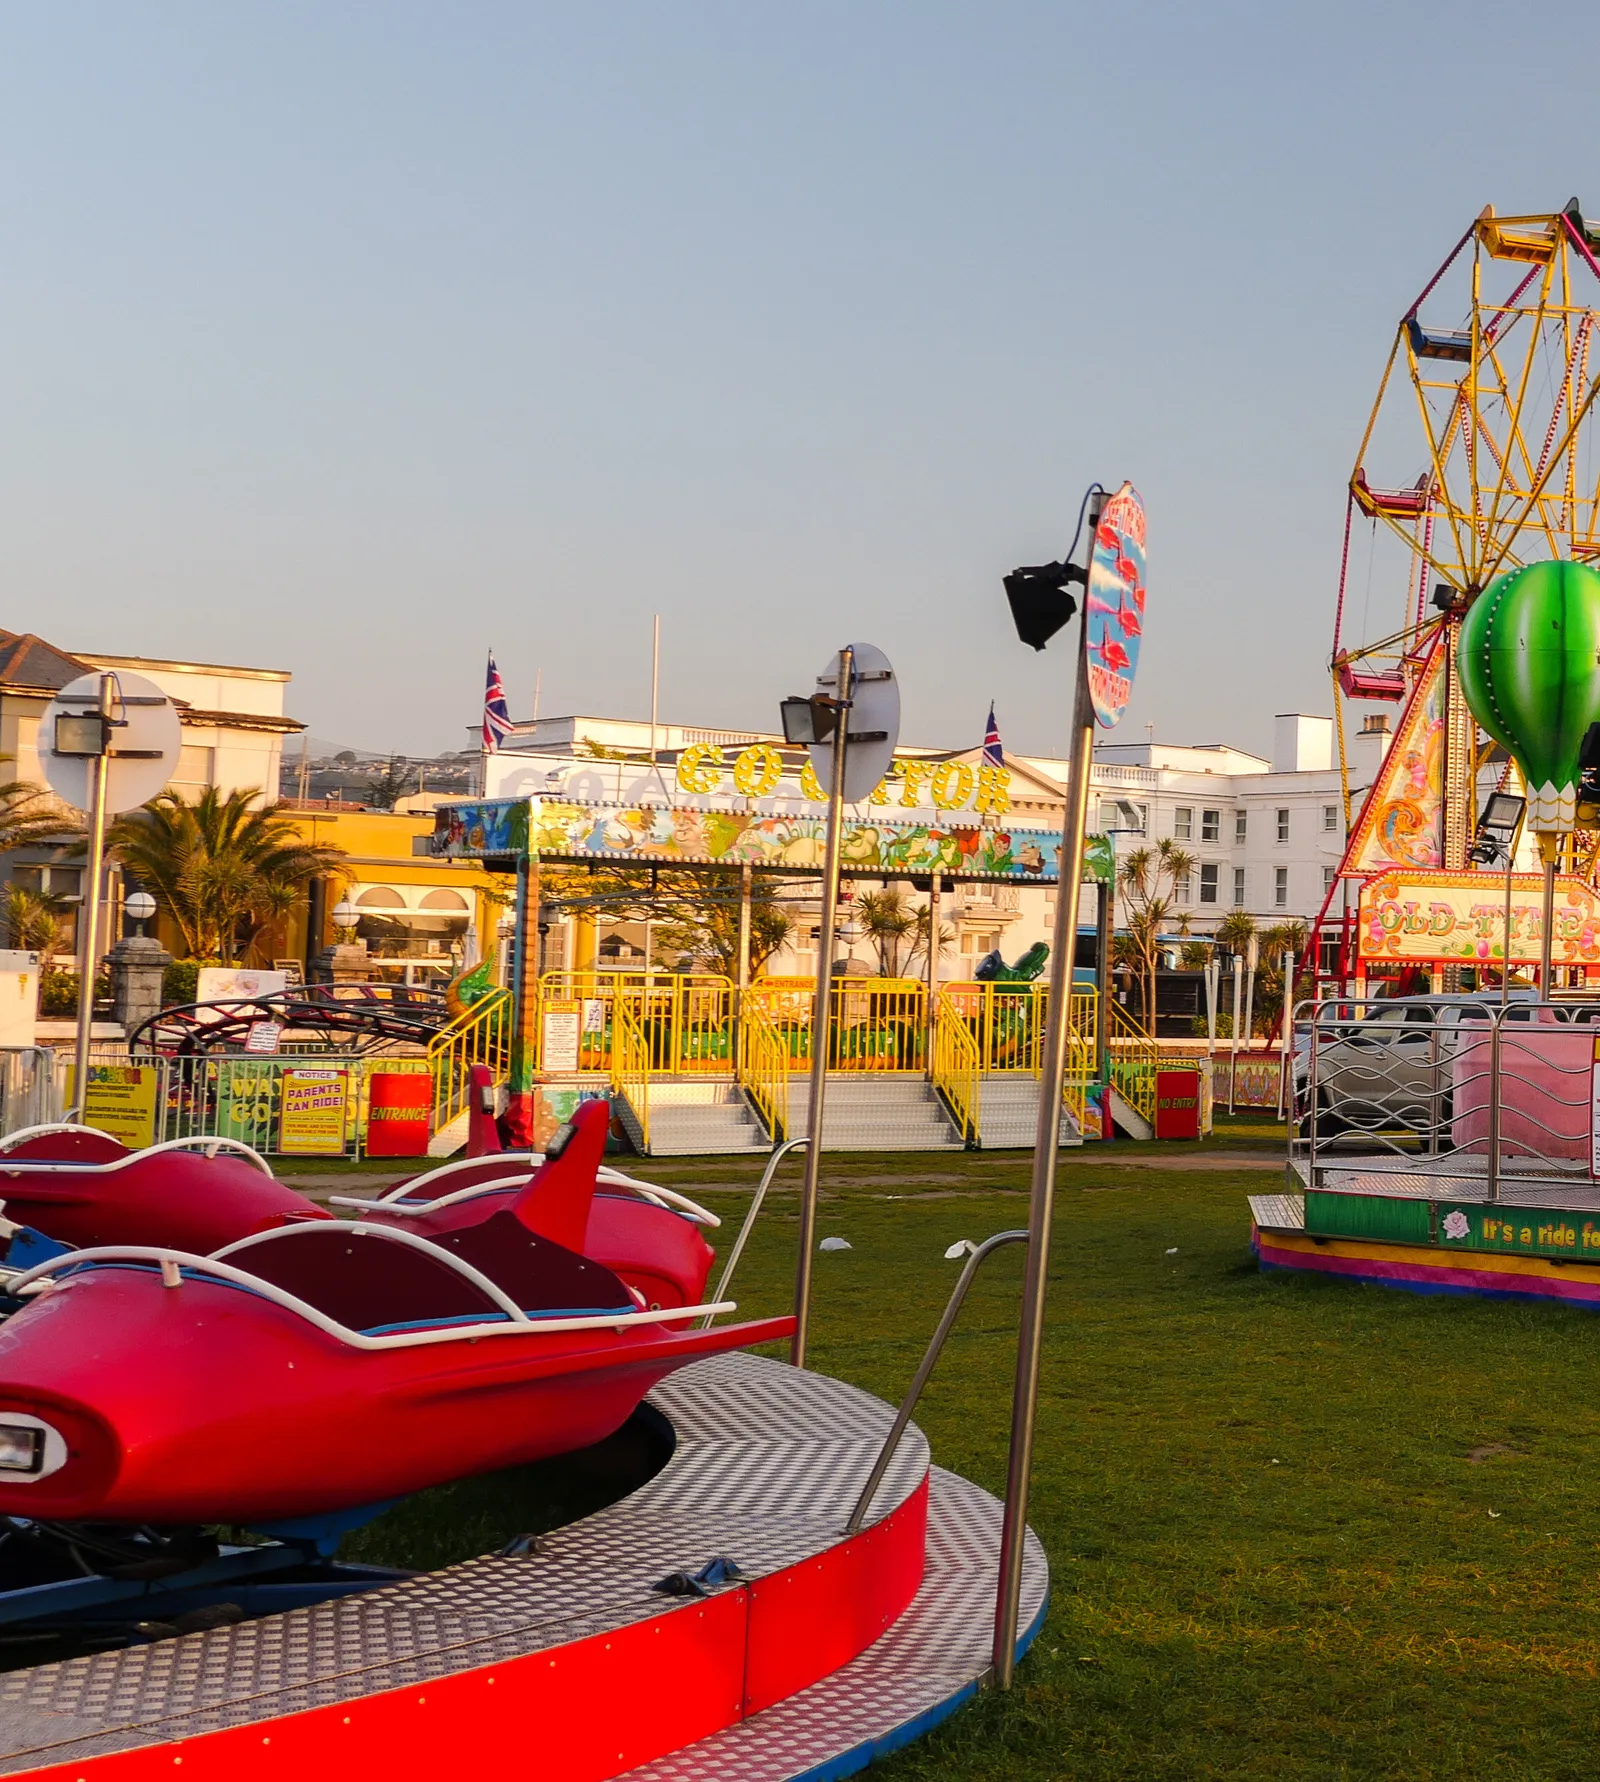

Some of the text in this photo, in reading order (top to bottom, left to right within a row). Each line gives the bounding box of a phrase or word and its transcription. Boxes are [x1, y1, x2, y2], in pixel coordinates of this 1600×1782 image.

[677, 743, 782, 797] GO
[775, 980, 814, 988] ENTRANCE
[288, 1084, 341, 1099] PARENTS
[286, 1096, 343, 1113] CAN RIDE!
[1159, 1098, 1170, 1108] NO
[1172, 1097, 1197, 1108] ENTRY
[371, 1107, 428, 1121] ENTRANCE
[1482, 1218, 1513, 1242] It's
[1519, 1226, 1531, 1245] a
[1538, 1223, 1576, 1248] ride
